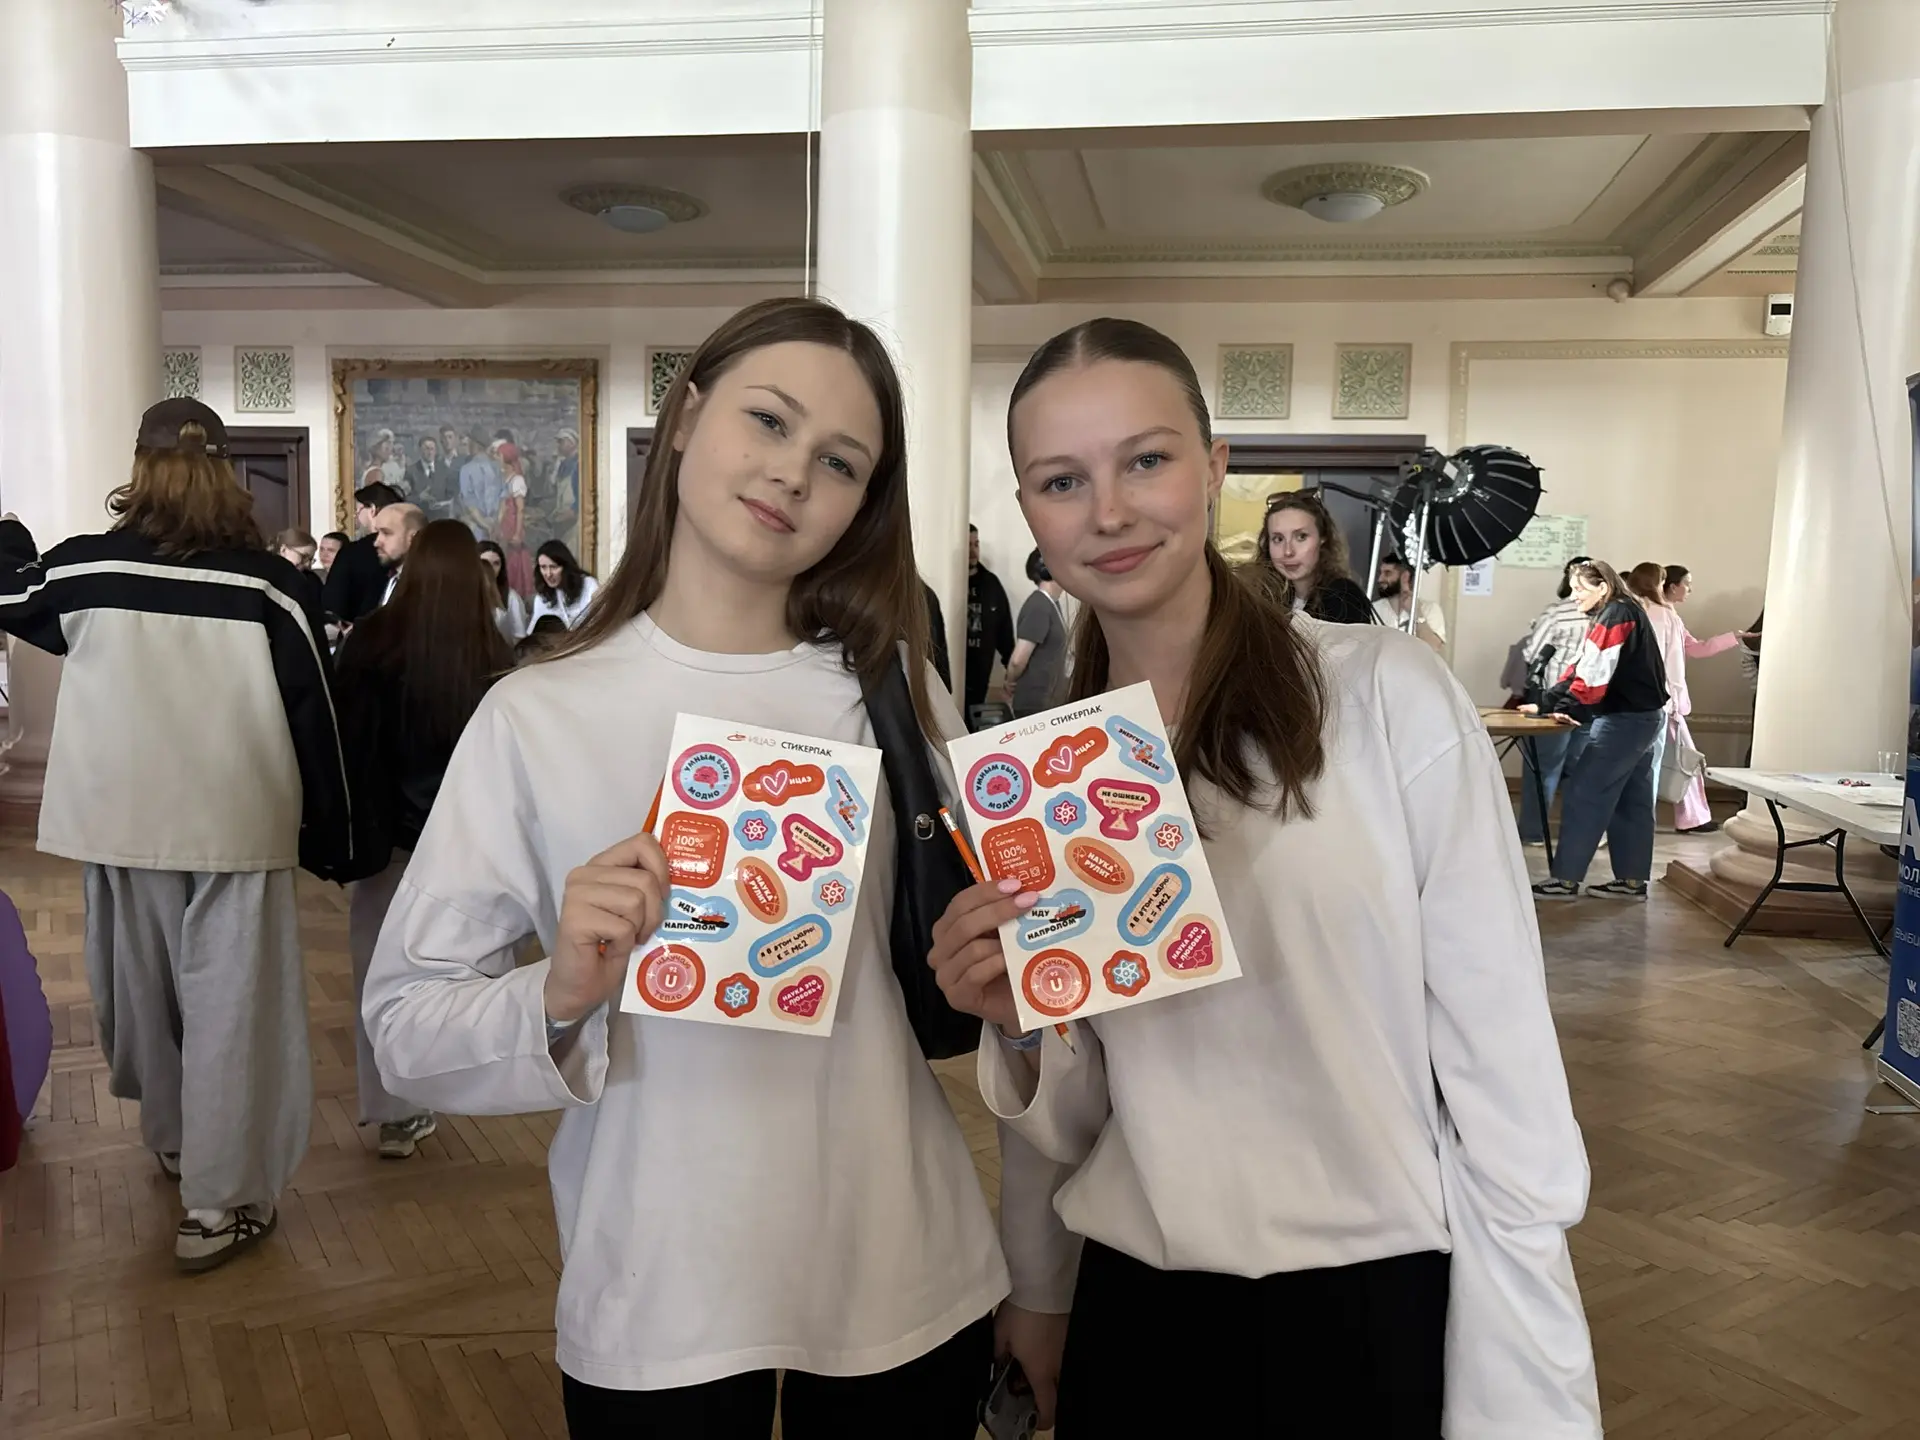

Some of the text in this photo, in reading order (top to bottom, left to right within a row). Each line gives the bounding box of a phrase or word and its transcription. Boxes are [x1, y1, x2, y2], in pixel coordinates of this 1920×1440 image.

[1050, 705, 1103, 727] СТИКЕРПАК
[781, 741, 833, 757] СТИКЕРПАК
[1073, 739, 1096, 756] ИЦАЭ
[684, 754, 716, 772] УМНЫМ
[789, 776, 812, 786] ИЦАЭ
[976, 764, 1019, 792] УМНЫМ БЫТЬ
[687, 786, 721, 800] МОДНО
[988, 794, 1018, 810] МОДНО
[676, 834, 705, 848] 100%
[998, 843, 1027, 860] 100%
[1084, 859, 1110, 878] РУЛИТ
[1087, 852, 1114, 873] НАУКА
[749, 880, 767, 904] РУЛИТ
[755, 875, 774, 901] НАУКА
[678, 901, 696, 914] ИДУ
[1031, 909, 1050, 918] ИДУ
[664, 921, 716, 931] НАПРОЛОМ
[1027, 918, 1076, 940] НАПРОЛОМ
[1171, 926, 1199, 960] НАУКА ЭТО
[1180, 934, 1203, 961] ЛЮБОВЬ
[665, 974, 678, 988] U
[1050, 977, 1063, 992] U
[782, 979, 817, 1002] НАУКА ЭТО
[789, 988, 817, 1006] ЛЮБОВЬ
